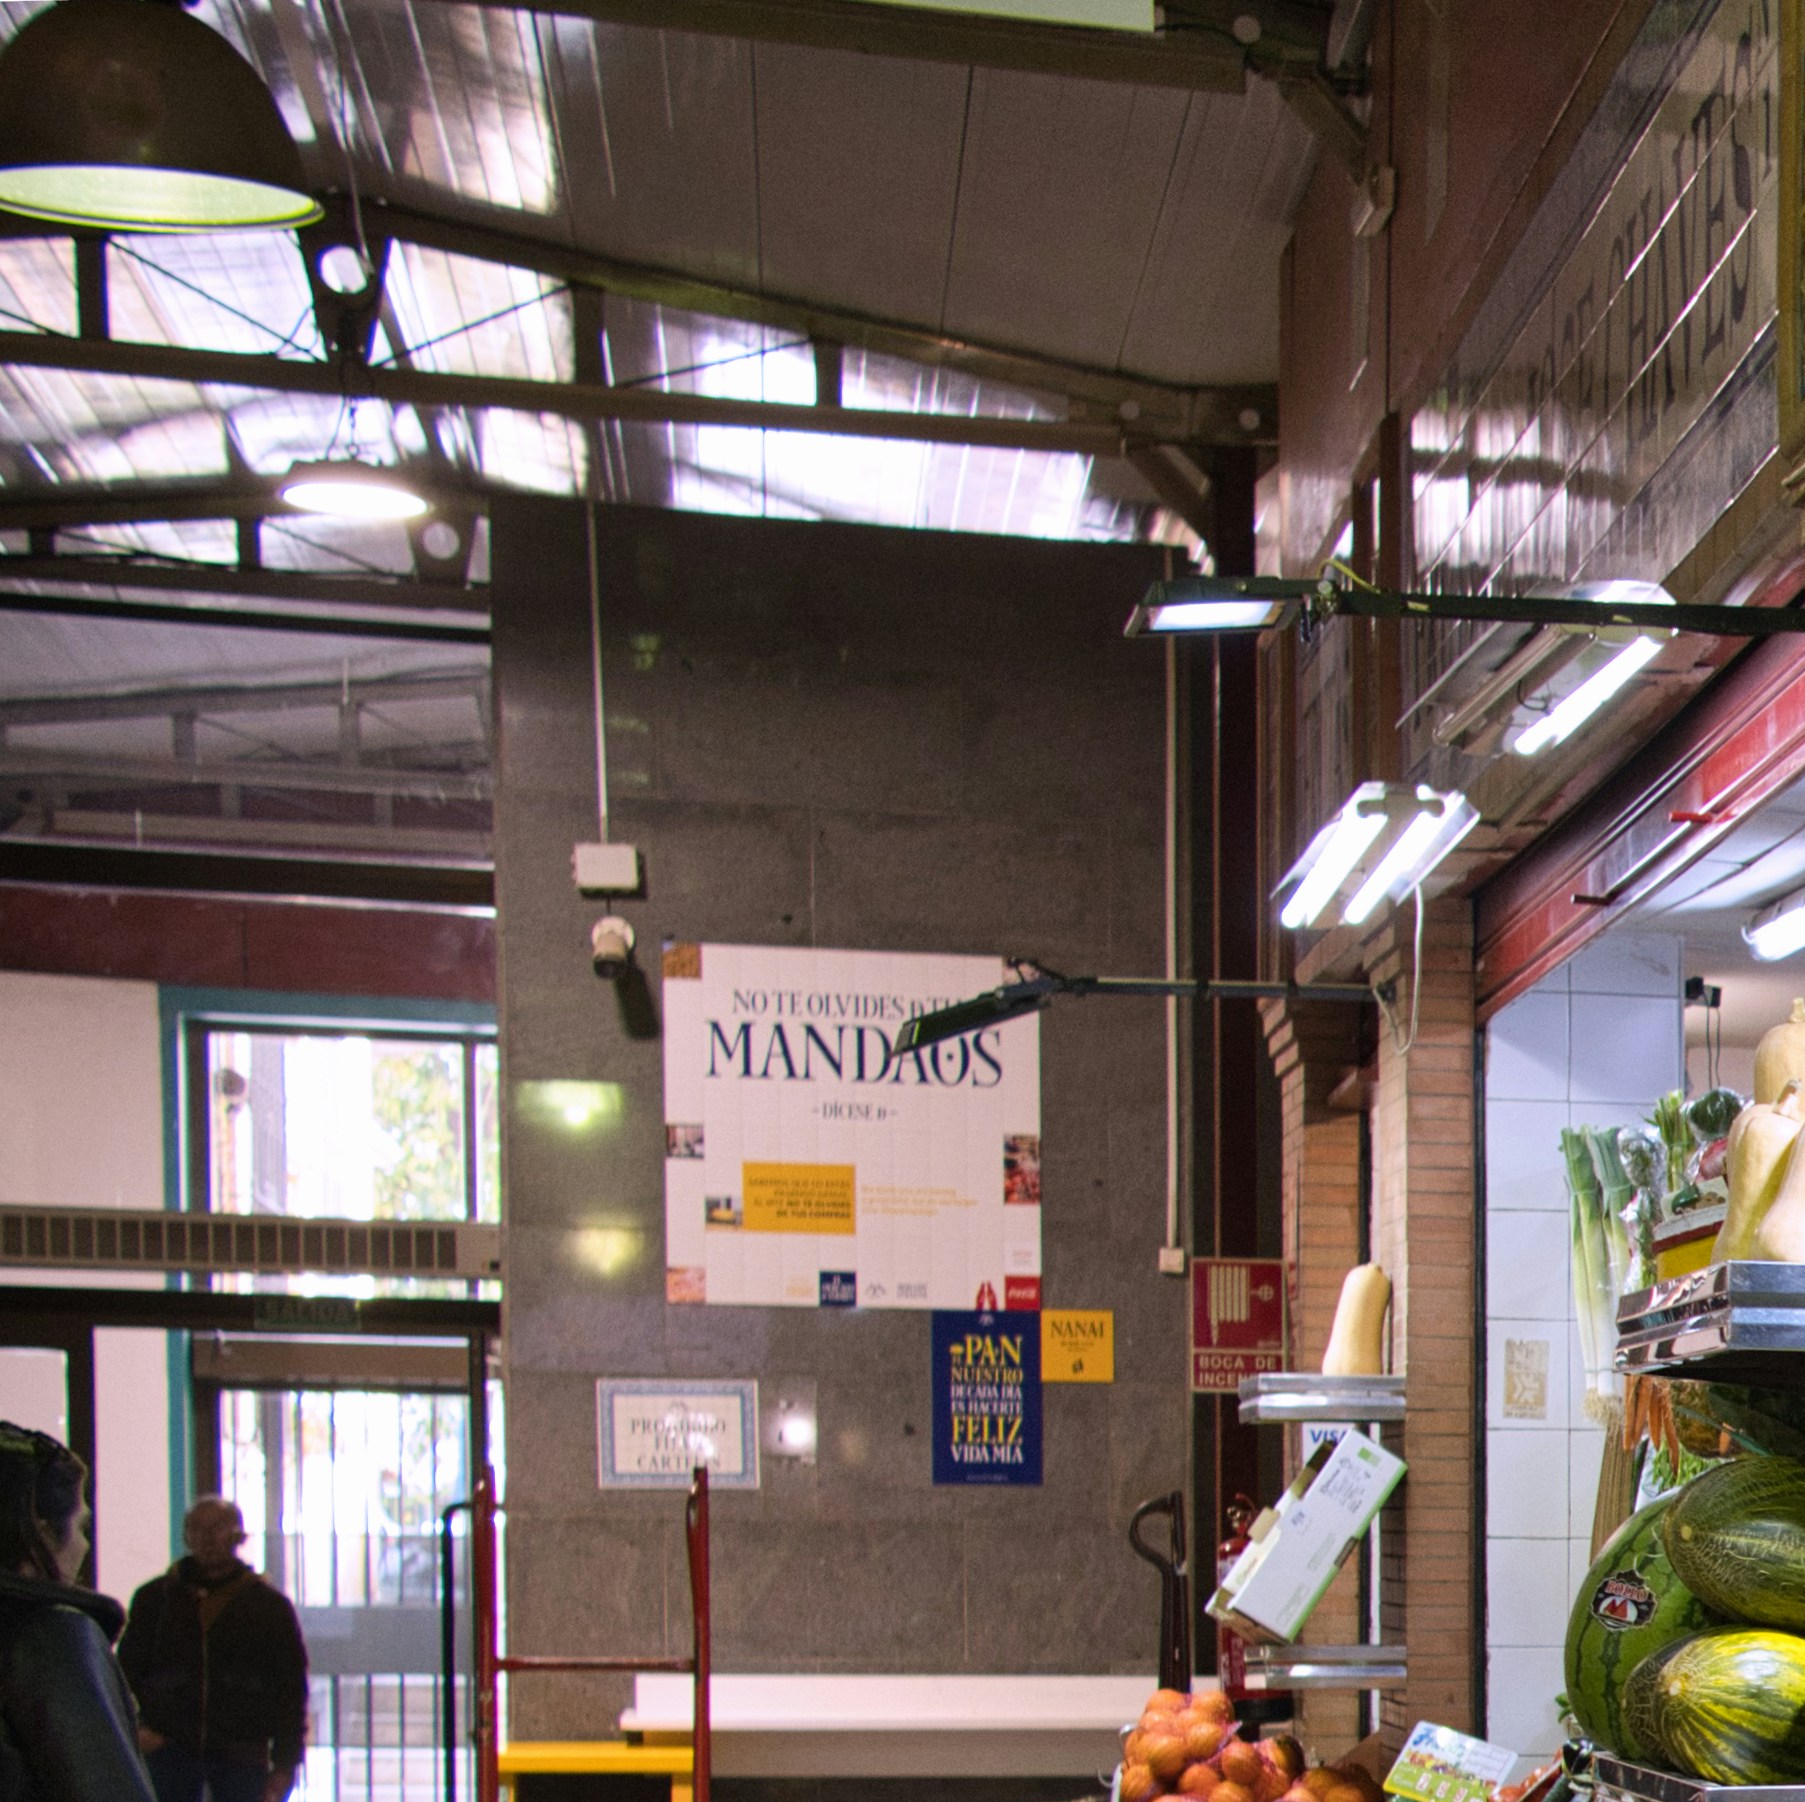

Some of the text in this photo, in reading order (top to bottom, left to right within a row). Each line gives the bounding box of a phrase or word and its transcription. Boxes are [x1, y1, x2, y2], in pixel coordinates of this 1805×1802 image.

[733, 988, 769, 1015] NO
[773, 990, 803, 1016] TE
[805, 991, 904, 1020] OLVIDES
[1198, 1355, 1277, 1370] BOCA DE
[1198, 1372, 1247, 1386] INCEN
[952, 1415, 1022, 1444] FELIZ
[951, 1444, 989, 1464] VIDA
